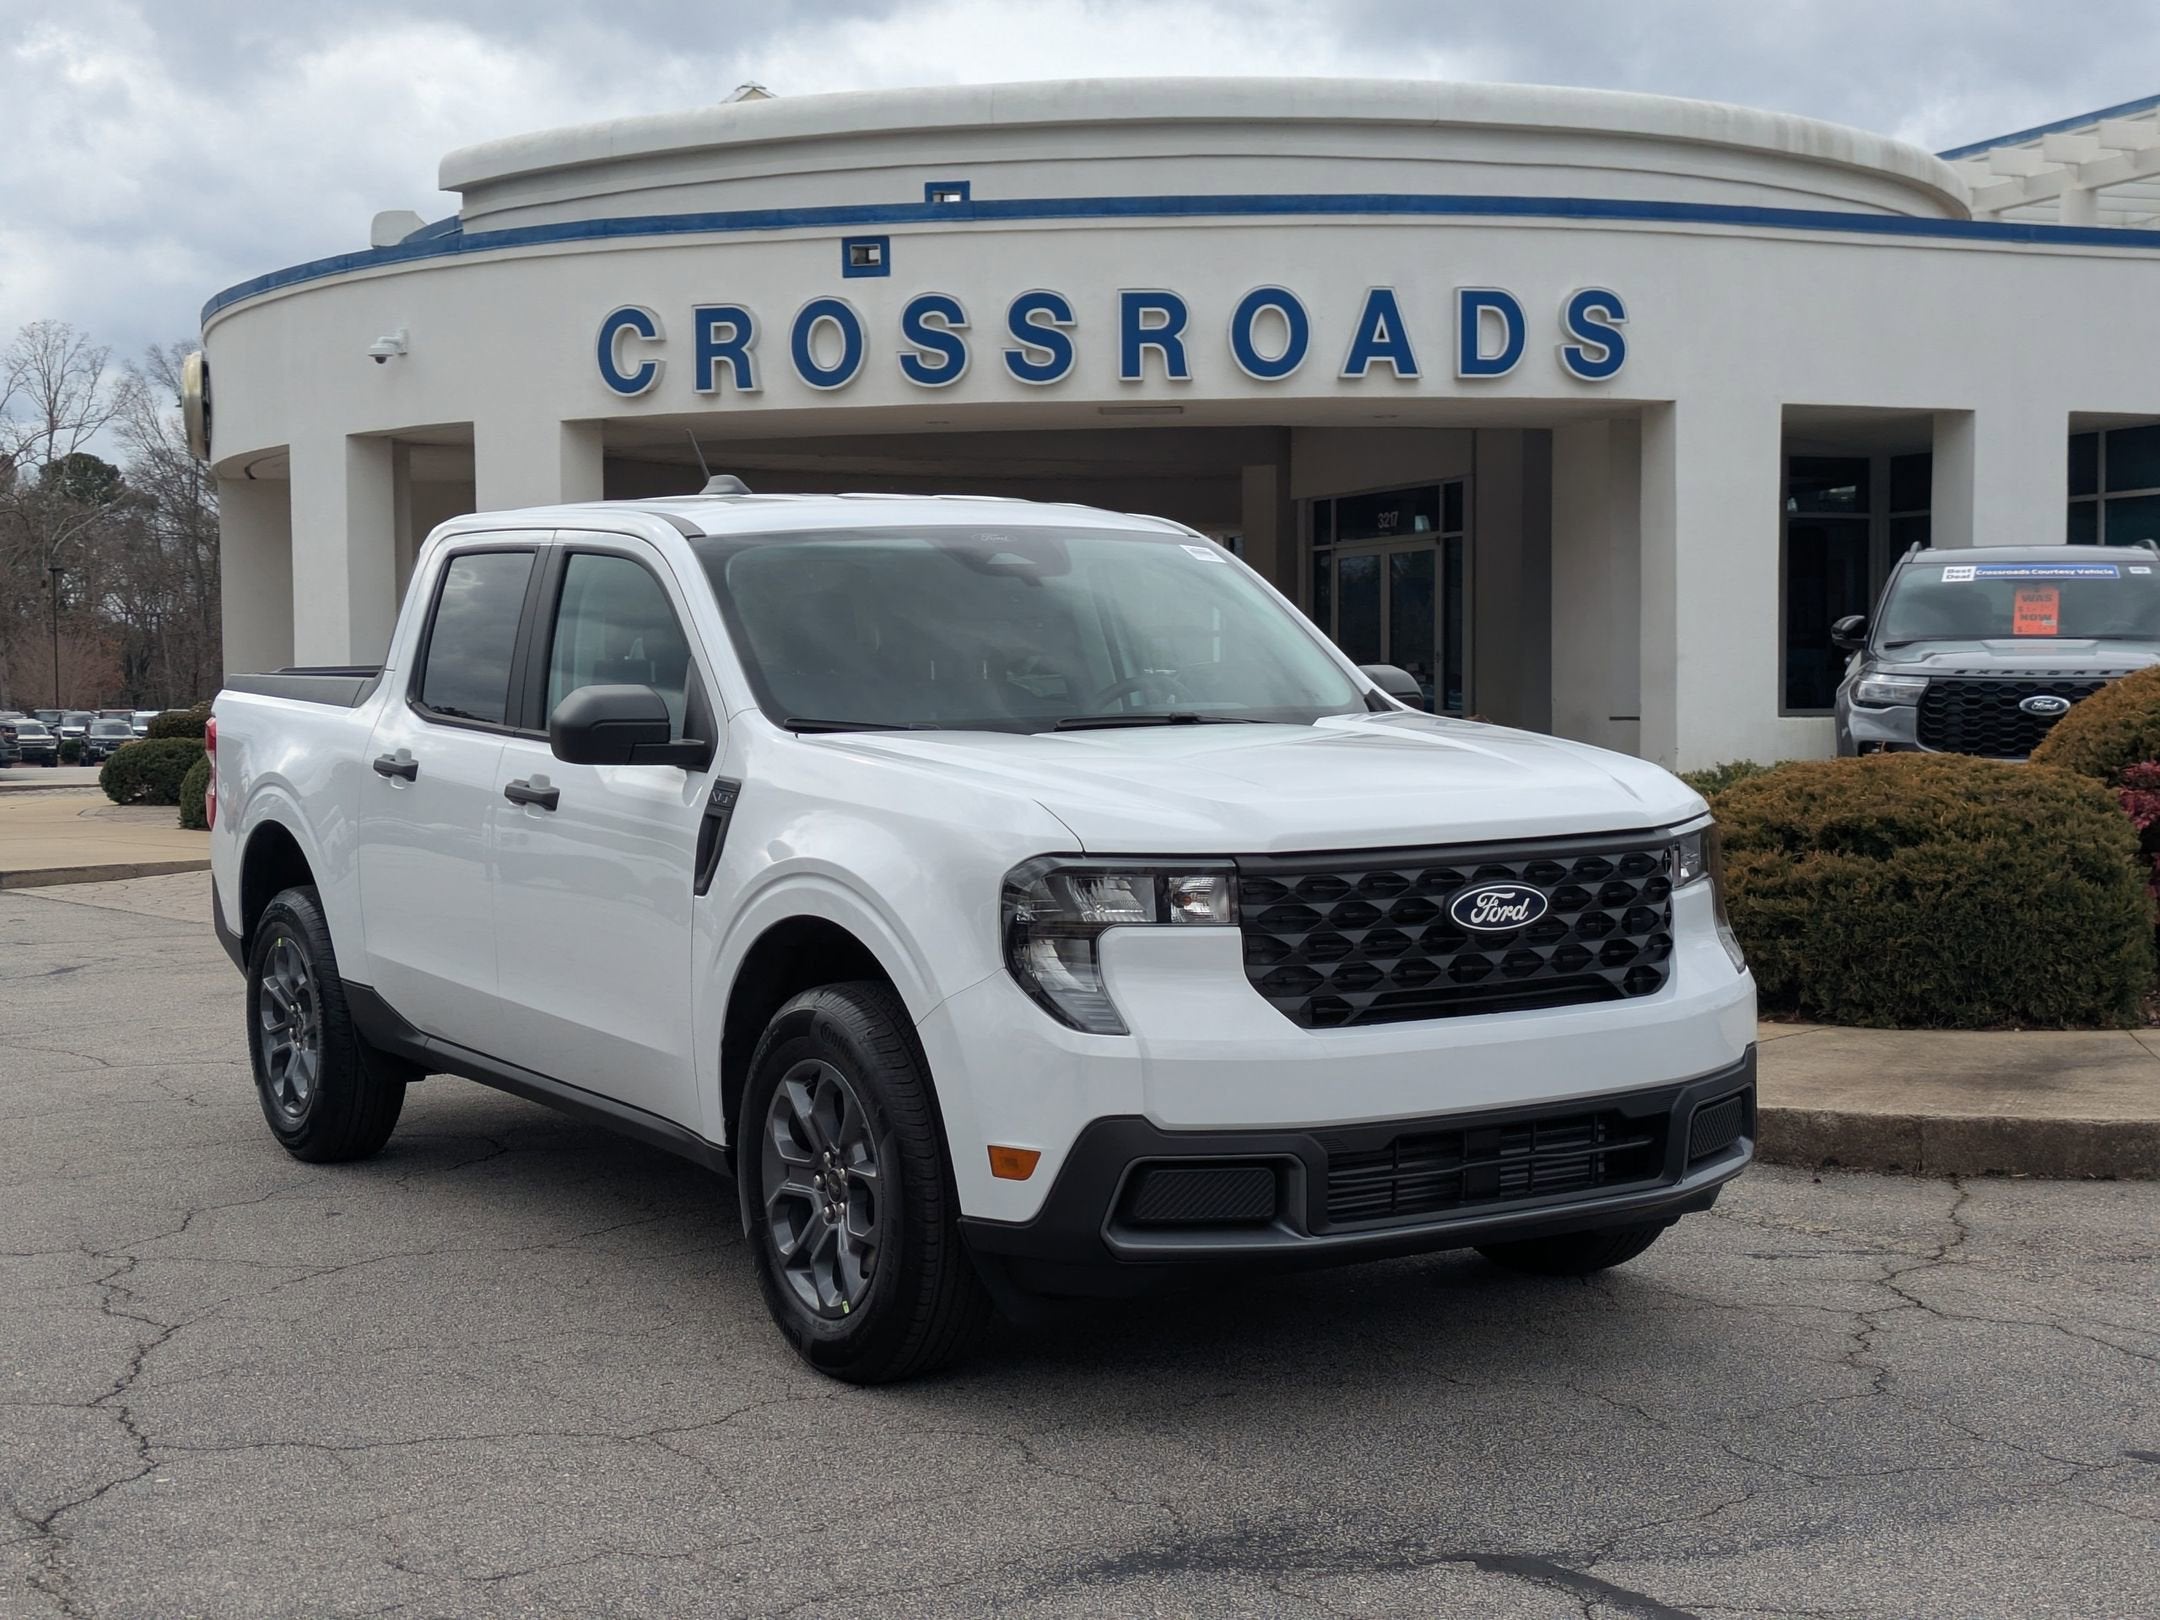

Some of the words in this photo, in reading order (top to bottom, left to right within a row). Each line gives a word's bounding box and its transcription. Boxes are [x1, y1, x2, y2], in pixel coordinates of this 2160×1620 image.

[595, 284, 1629, 397] CROSSROADS
[1377, 511, 1399, 528] 3217
[2022, 592, 2053, 602] WAS
[1470, 892, 1530, 923] Ford
